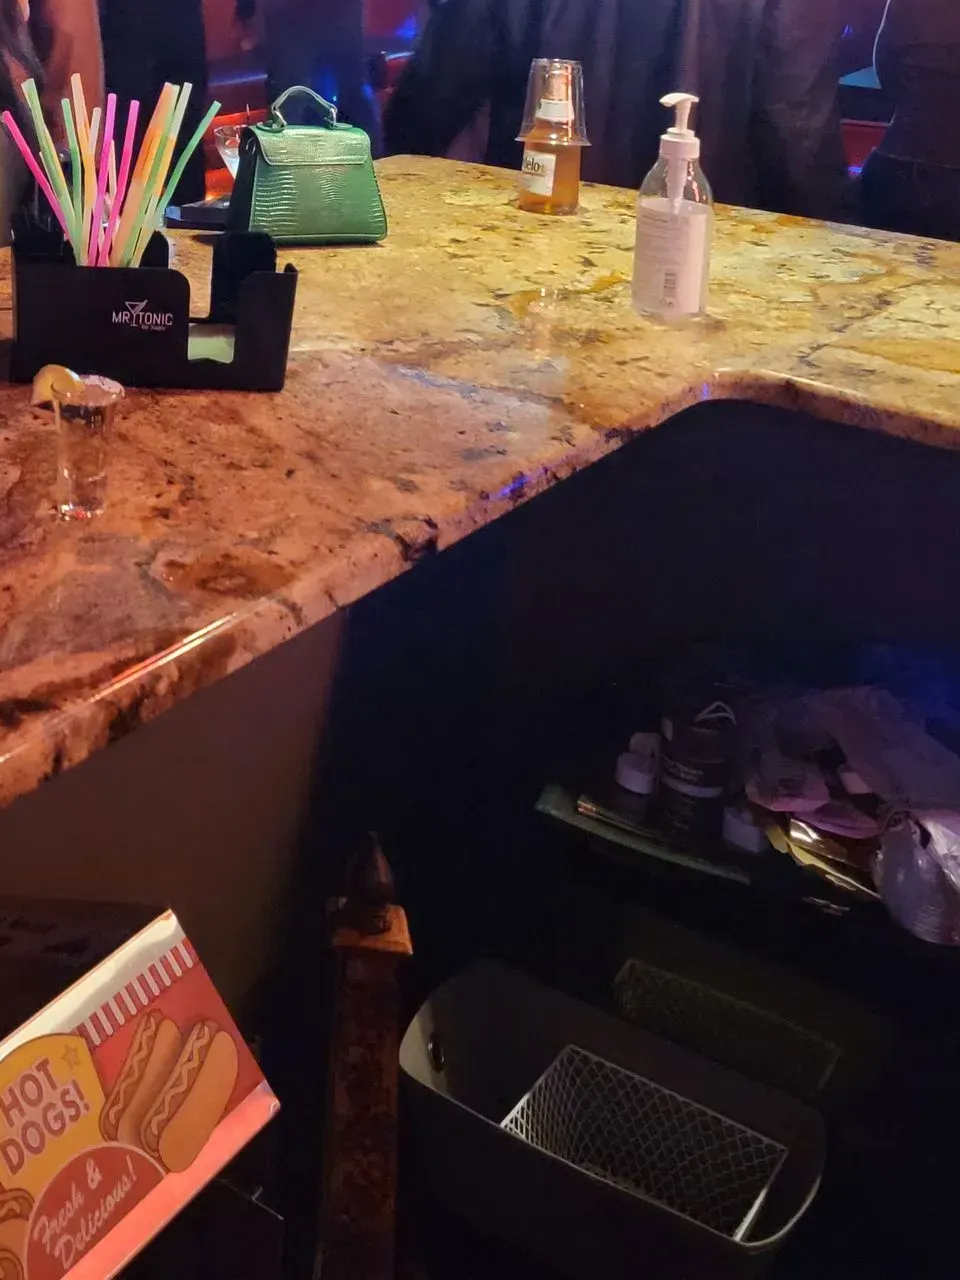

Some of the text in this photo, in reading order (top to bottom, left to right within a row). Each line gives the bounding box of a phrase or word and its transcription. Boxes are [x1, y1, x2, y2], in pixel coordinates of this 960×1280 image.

[112, 310, 173, 326] MR TONIC
[0, 1079, 90, 1175] DOGS!
[33, 1158, 102, 1255] Fresh &
[54, 1155, 137, 1270] Delicious!
